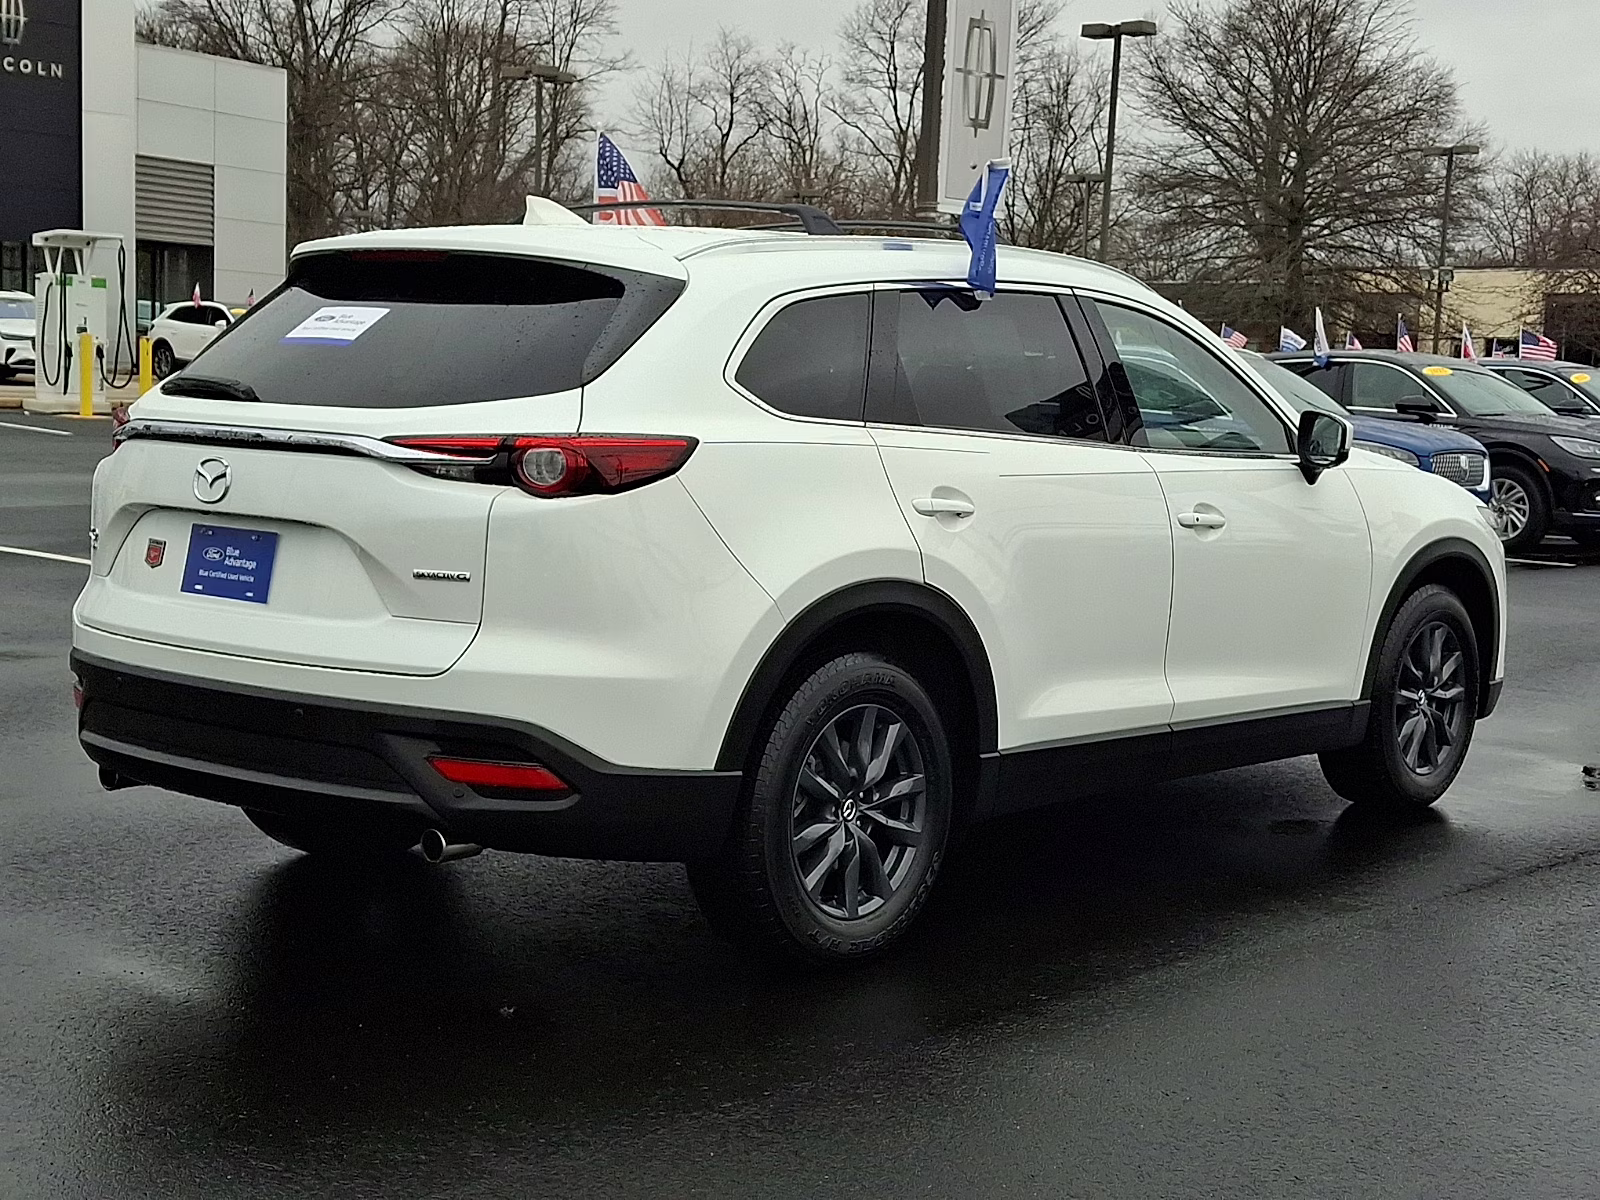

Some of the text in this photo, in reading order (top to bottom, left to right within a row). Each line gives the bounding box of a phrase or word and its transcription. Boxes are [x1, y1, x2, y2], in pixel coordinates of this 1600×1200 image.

[226, 546, 240, 557] Blue
[224, 557, 257, 570] Advantage
[199, 568, 209, 577] Blue
